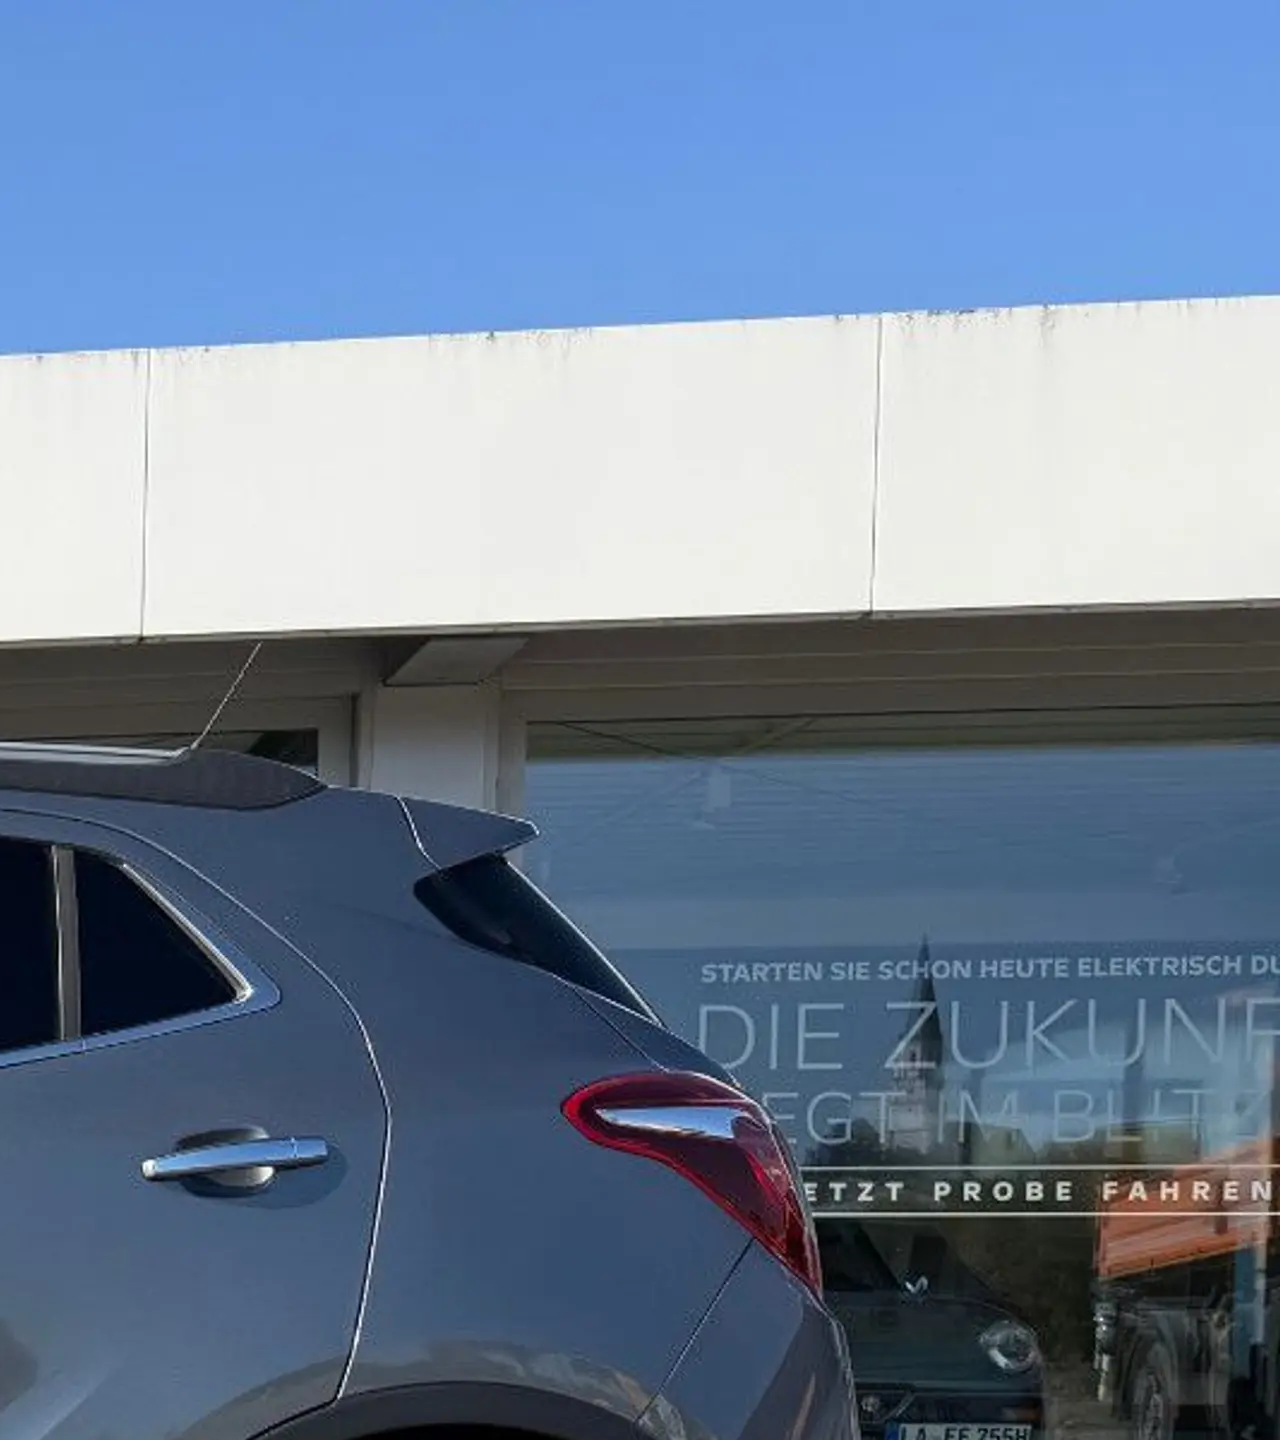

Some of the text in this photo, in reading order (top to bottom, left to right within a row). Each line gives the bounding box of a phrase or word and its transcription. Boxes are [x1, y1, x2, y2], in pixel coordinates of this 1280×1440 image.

[699, 961, 823, 983] STARTEN
[830, 961, 871, 981] SIE
[878, 960, 972, 981] SCHON
[980, 958, 1070, 979] HEUTE
[1077, 955, 1241, 977] ELEKTRISCH
[698, 1002, 845, 1070] DIE
[937, 1088, 1019, 1144] IM
[803, 1180, 1273, 1202] ETZT PROBE FAHREN
